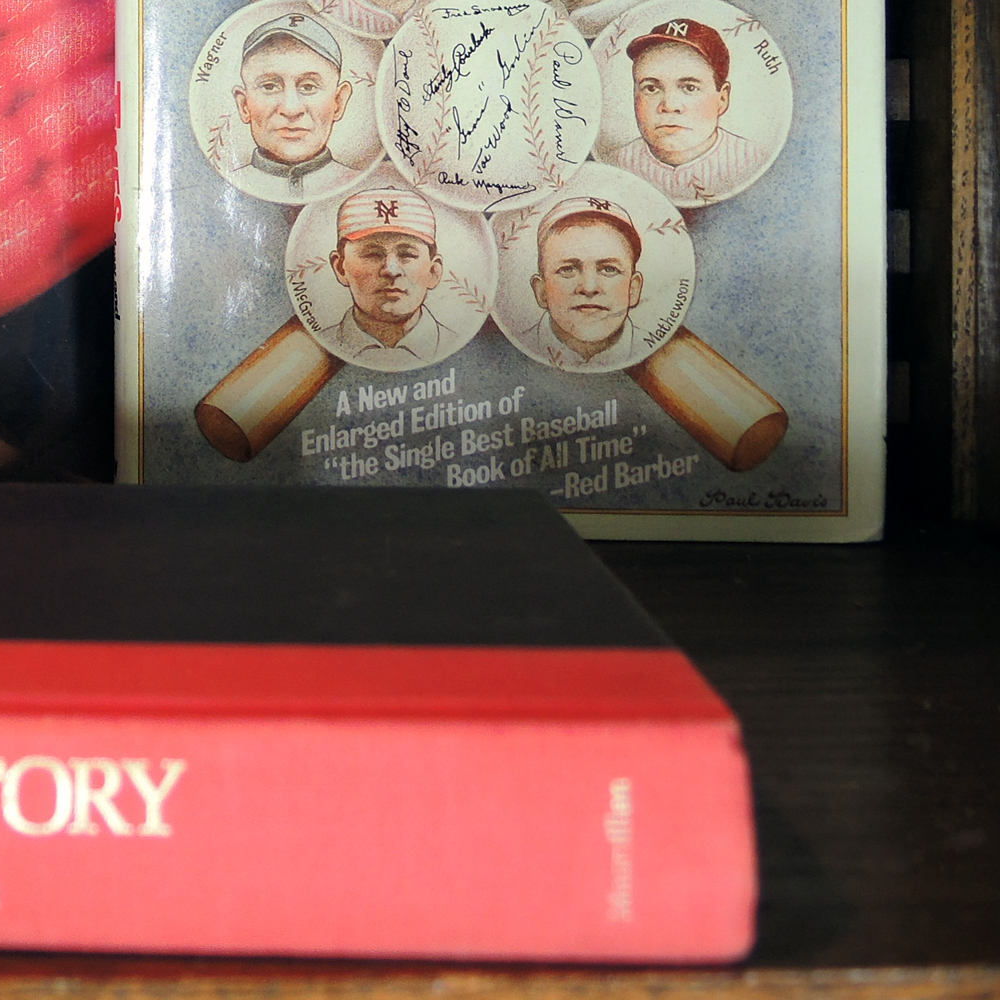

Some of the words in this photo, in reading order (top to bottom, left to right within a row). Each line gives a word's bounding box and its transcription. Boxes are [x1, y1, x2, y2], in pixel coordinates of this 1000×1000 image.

[194, 30, 228, 84] Wagner
[753, 38, 783, 76] Ruth
[291, 280, 322, 333] McGraw
[642, 277, 690, 349] Mathewson
[336, 390, 351, 418] A
[358, 384, 408, 413] New
[413, 367, 456, 401] and
[302, 410, 405, 457] Enlarged
[411, 398, 492, 434] Edition
[498, 385, 526, 416] of
[324, 452, 380, 481] “the
[384, 434, 456, 470] Single
[460, 422, 515, 457] Best
[520, 398, 619, 445] Baseball
[446, 455, 506, 489] Book
[510, 447, 538, 477] of
[539, 440, 569, 472] All
[614, 453, 700, 490] Barber
